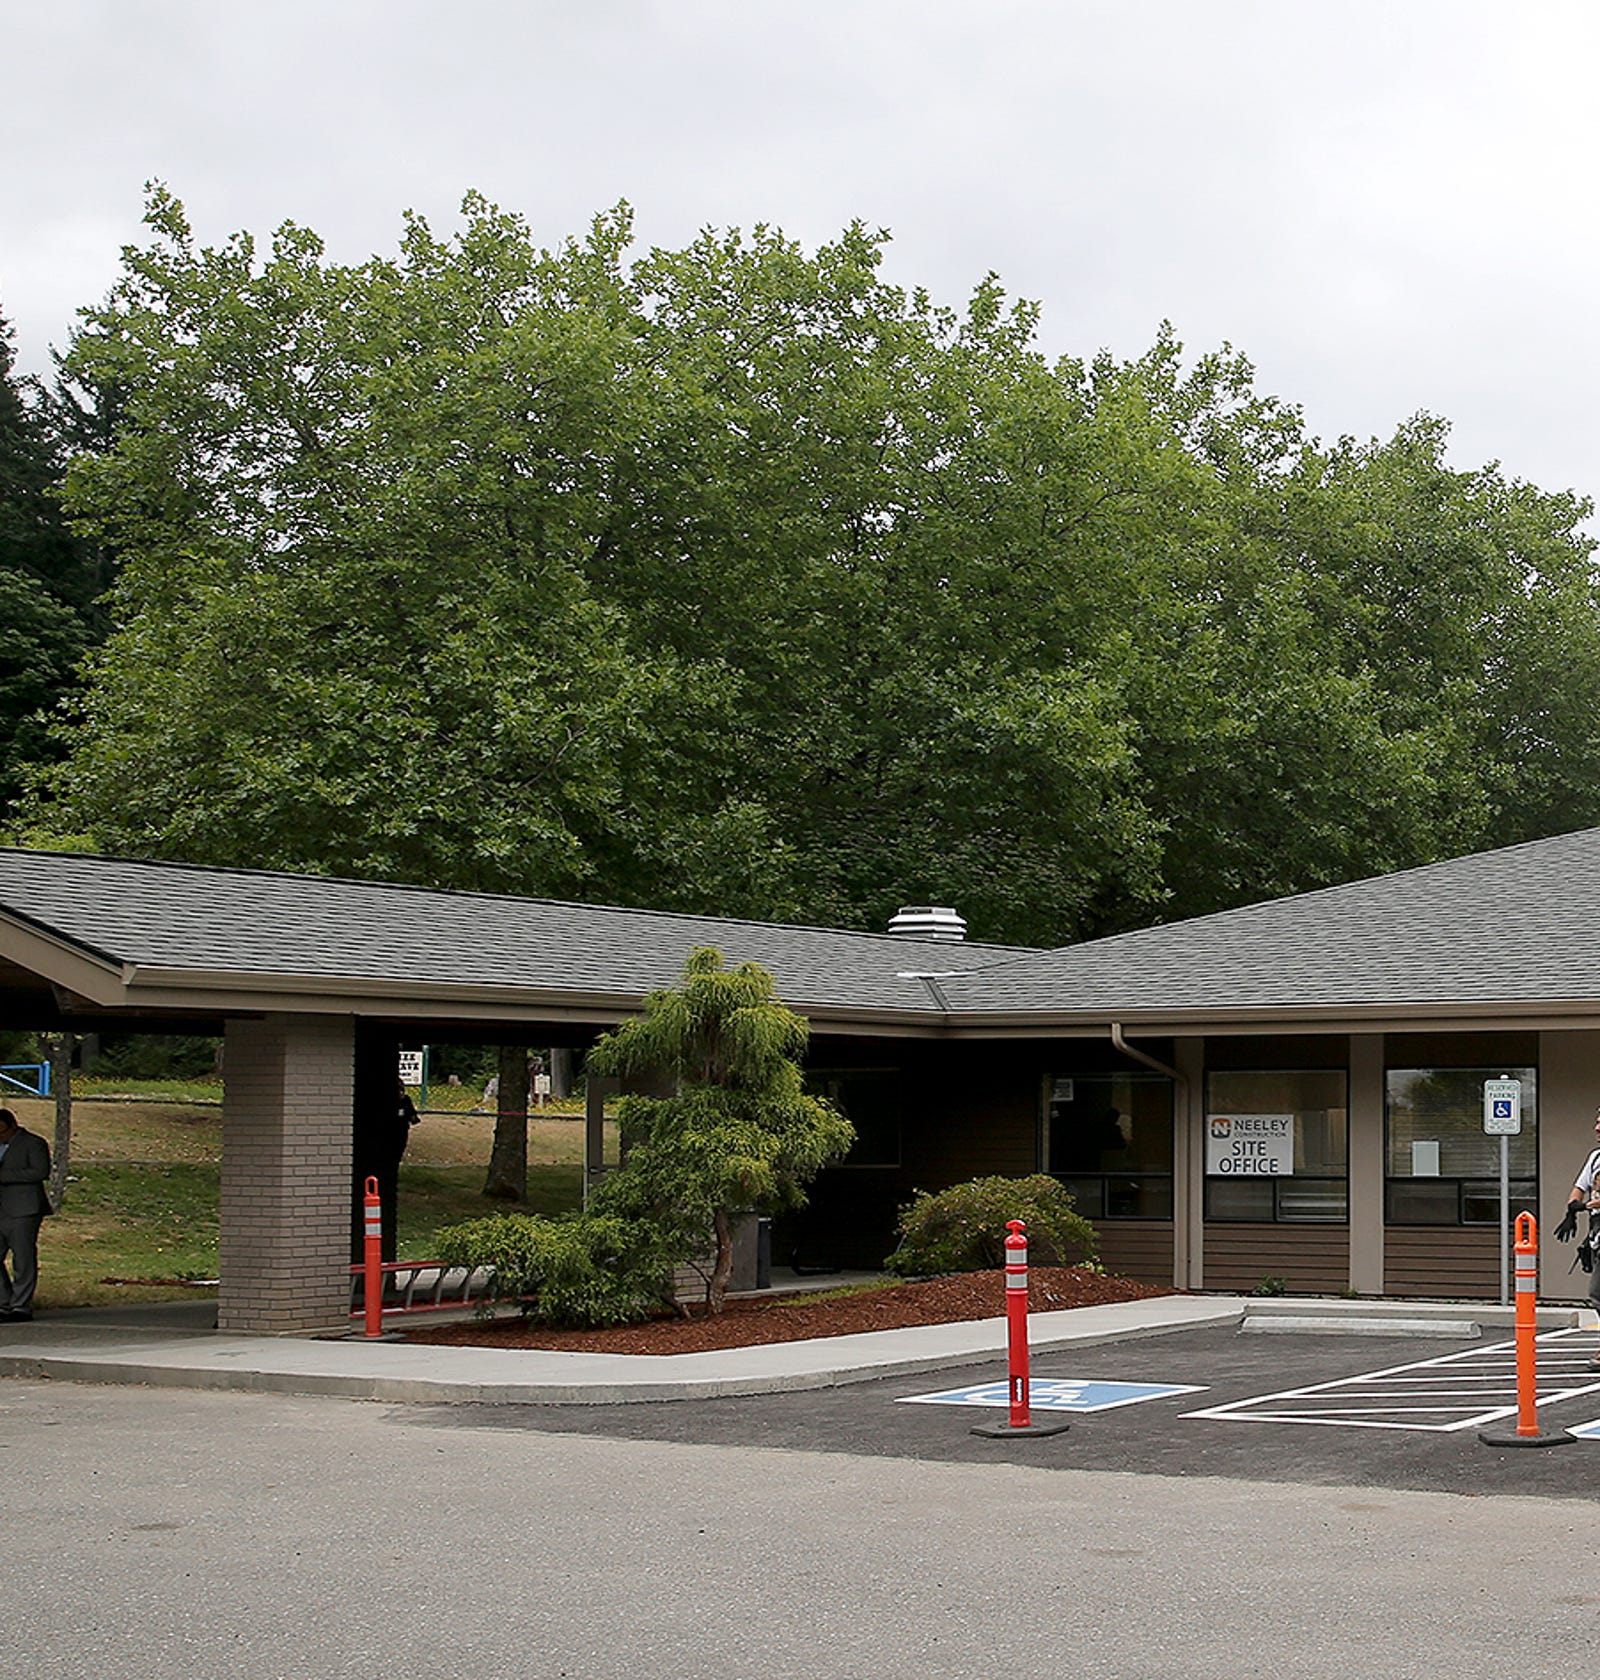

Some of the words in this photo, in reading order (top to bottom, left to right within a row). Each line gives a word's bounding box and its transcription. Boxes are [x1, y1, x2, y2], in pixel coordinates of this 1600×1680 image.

[1234, 1120, 1288, 1131] NEELEY
[1232, 1141, 1266, 1156] SITE
[1219, 1158, 1278, 1173] OFFICE
